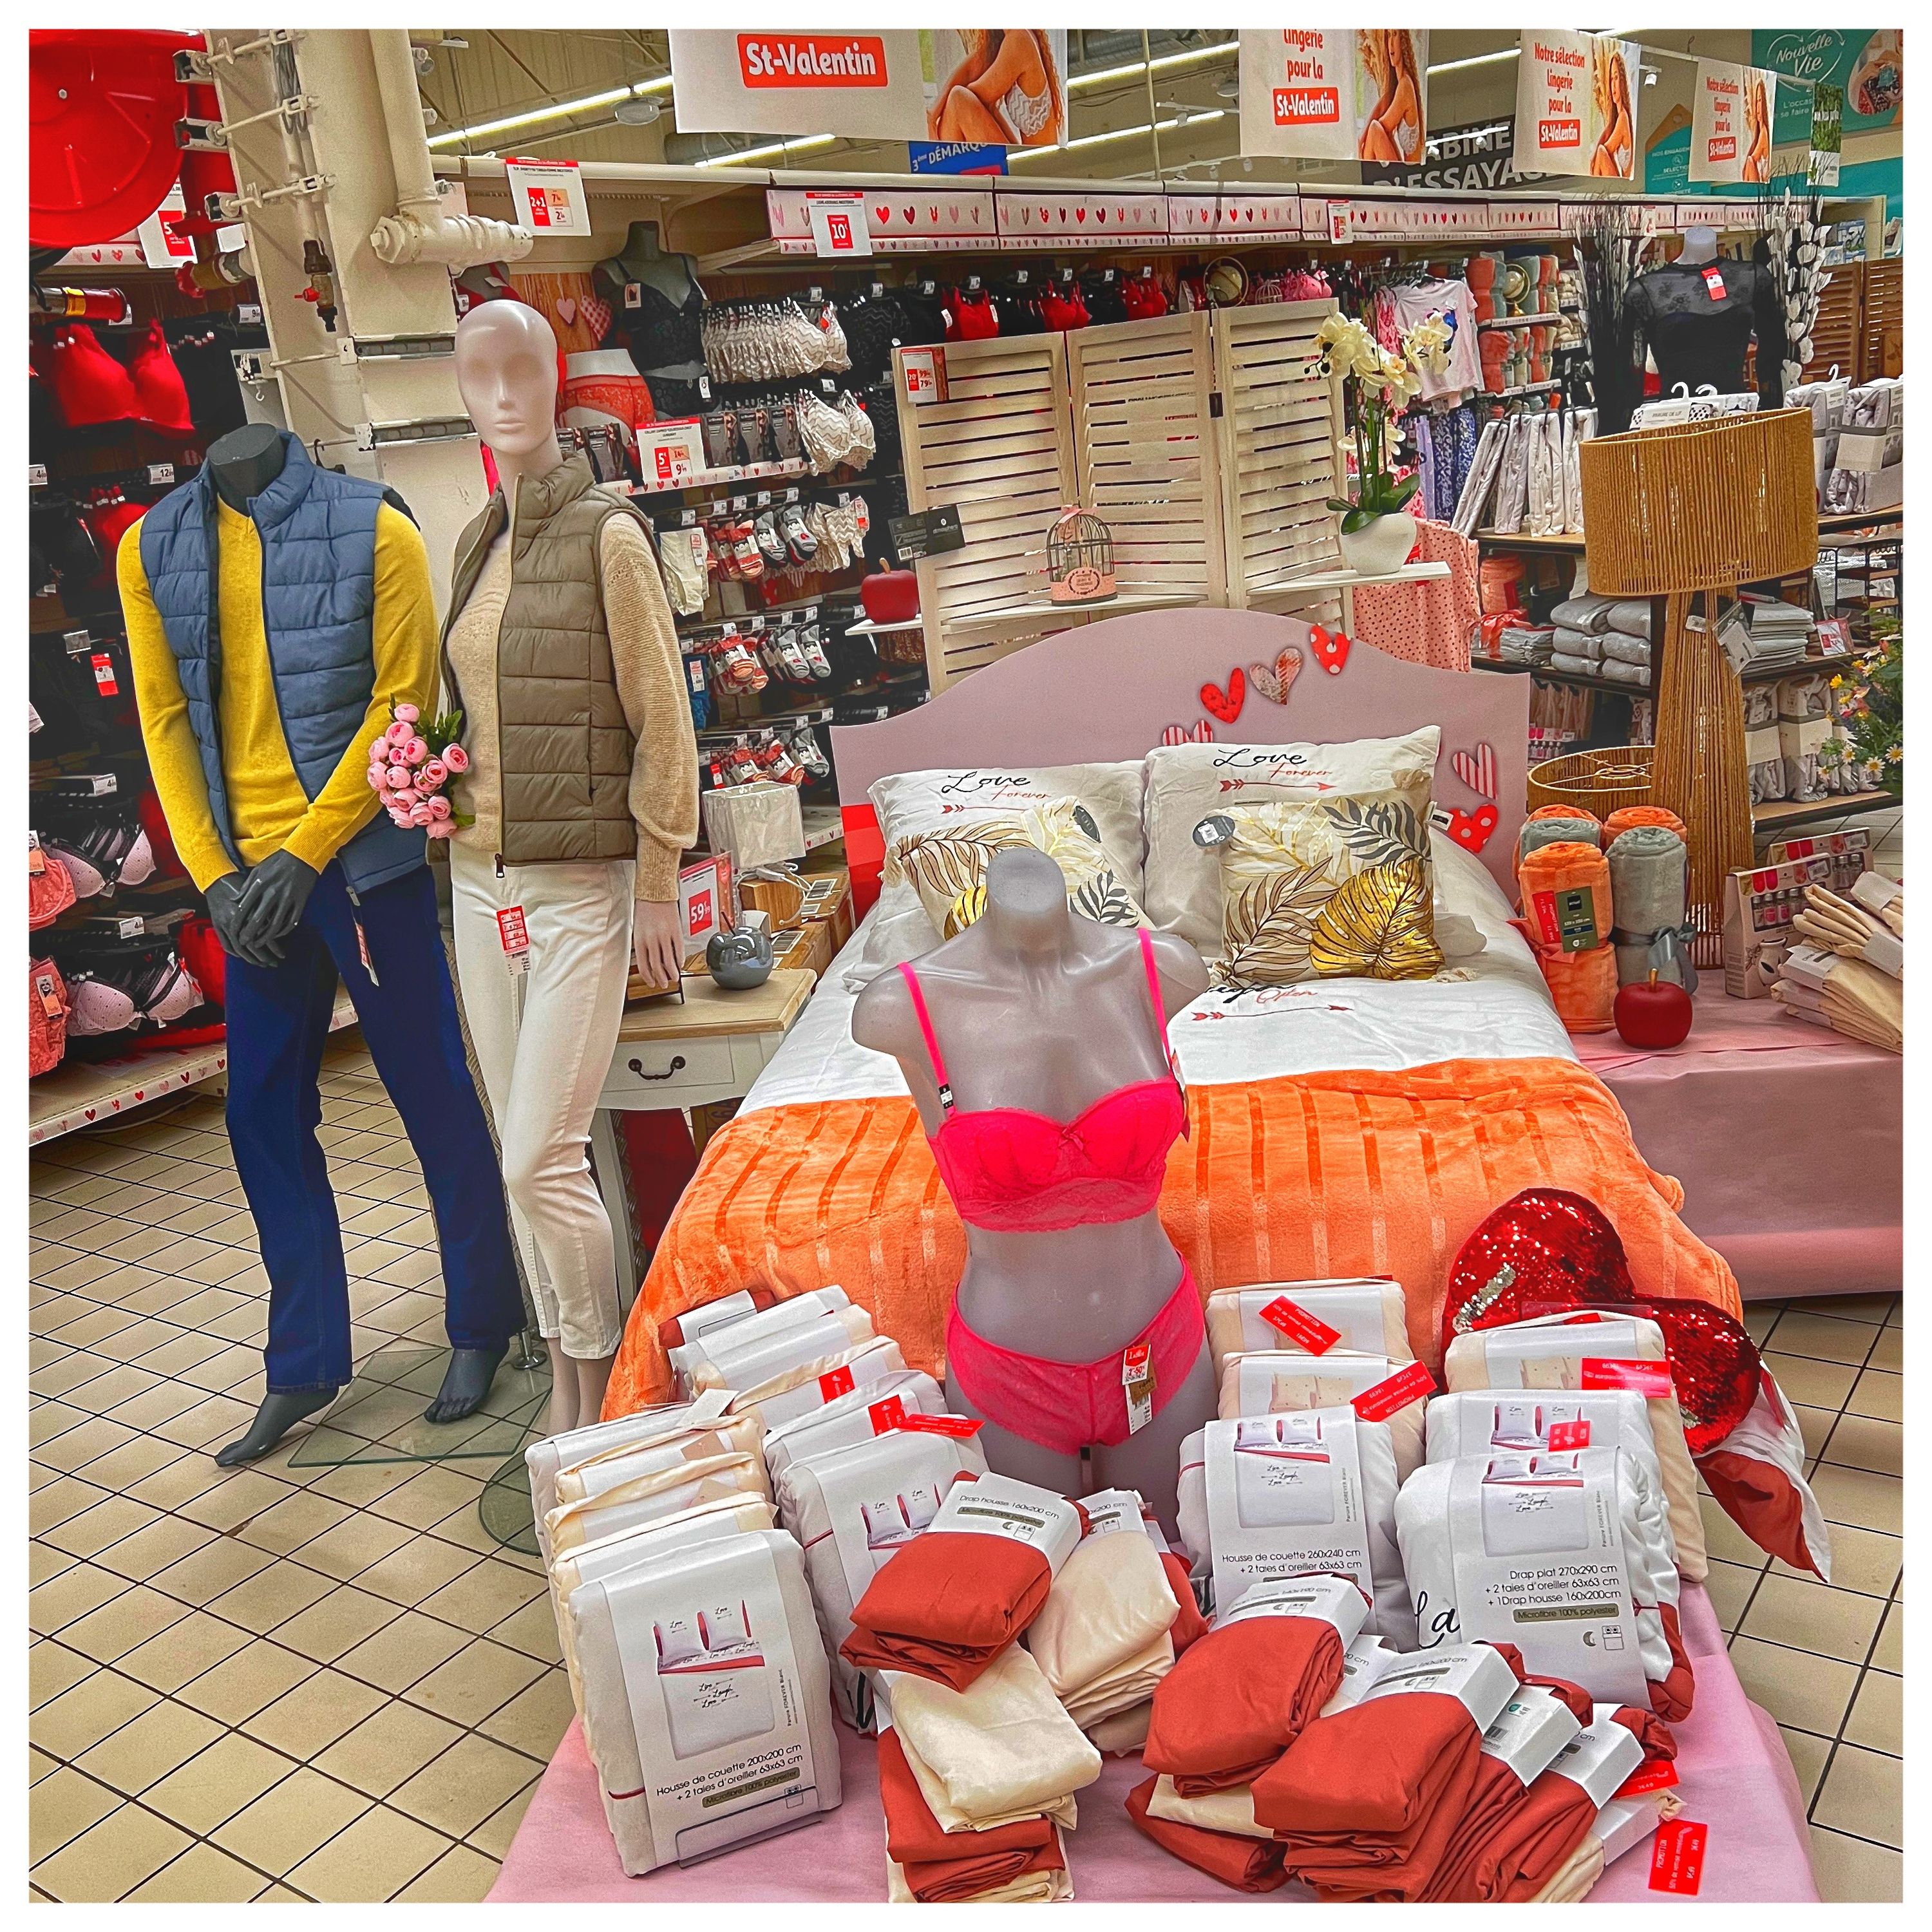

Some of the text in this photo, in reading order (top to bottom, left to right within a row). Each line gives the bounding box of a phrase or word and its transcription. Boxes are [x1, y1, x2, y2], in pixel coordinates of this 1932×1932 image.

[1535, 43, 1585, 68] Notre sélection
[1776, 33, 1833, 64] Nouvelle
[746, 42, 876, 75] St-Valentin
[1795, 54, 1823, 77] Vie
[1288, 56, 1323, 81] pour la
[1547, 69, 1573, 92] lingerie
[1276, 92, 1335, 117] St-Valentin
[1549, 96, 1572, 115] pour la
[1540, 121, 1578, 142] St-Valentin
[530, 196, 546, 207] 2+1
[1213, 748, 1307, 767] Love
[1266, 762, 1333, 778] Forever
[942, 771, 1030, 793] Love
[991, 784, 1052, 800] Forever
[1295, 1308, 1321, 1327] PROMOTION
[1385, 1394, 1415, 1414] PROMOTION
[960, 1495, 1060, 1520] Drap housse 160x200 cm
[1222, 1554, 1253, 1562] Housse
[1255, 1552, 1267, 1561] de
[1270, 1551, 1305, 1560] couette
[1308, 1549, 1343, 1558] 260x240
[1248, 1565, 1253, 1573] 2
[1256, 1564, 1276, 1573] taies
[1510, 1570, 1534, 1580] Drap
[1537, 1568, 1556, 1578] plat
[1558, 1565, 1598, 1576] 270x290
[1493, 1584, 1499, 1593] 2
[1502, 1584, 1524, 1593] taies
[1572, 1578, 1600, 1588] 63x63
[1529, 1593, 1563, 1604] housse
[1566, 1590, 1622, 1601] 160x200cm
[1580, 1606, 1616, 1616] polyester
[1354, 1657, 1370, 1666] cm
[657, 1744, 802, 1796] Housse de couette 200x200 cm
[685, 1790, 691, 1799] 2
[694, 1783, 715, 1796] taies
[759, 1759, 786, 1774] 63x63
[787, 1755, 803, 1765] cm
